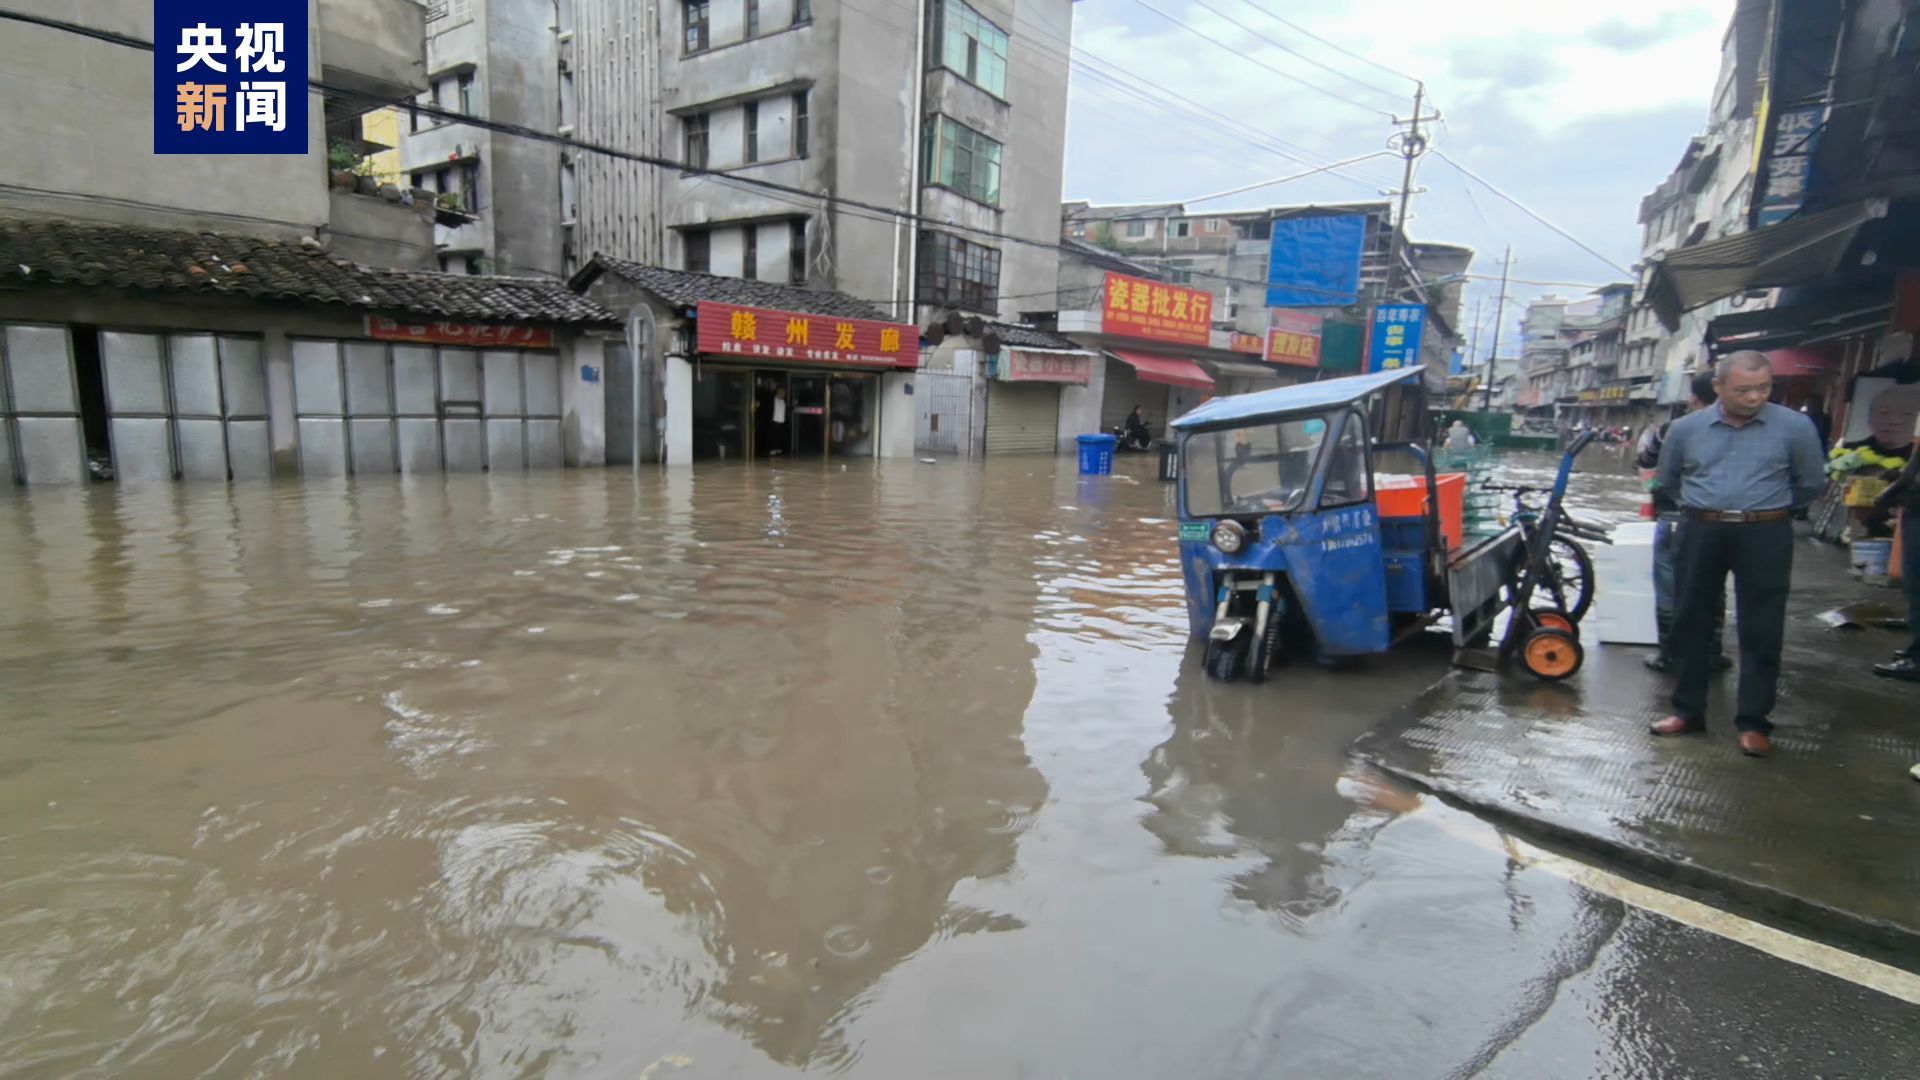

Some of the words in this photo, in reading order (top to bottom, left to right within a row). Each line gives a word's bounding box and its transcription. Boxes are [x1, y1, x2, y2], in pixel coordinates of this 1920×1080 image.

[1109, 278, 1208, 323] 瓷器批发行
[730, 311, 900, 353] 赣州发廊
[1272, 331, 1316, 358] 理发店
